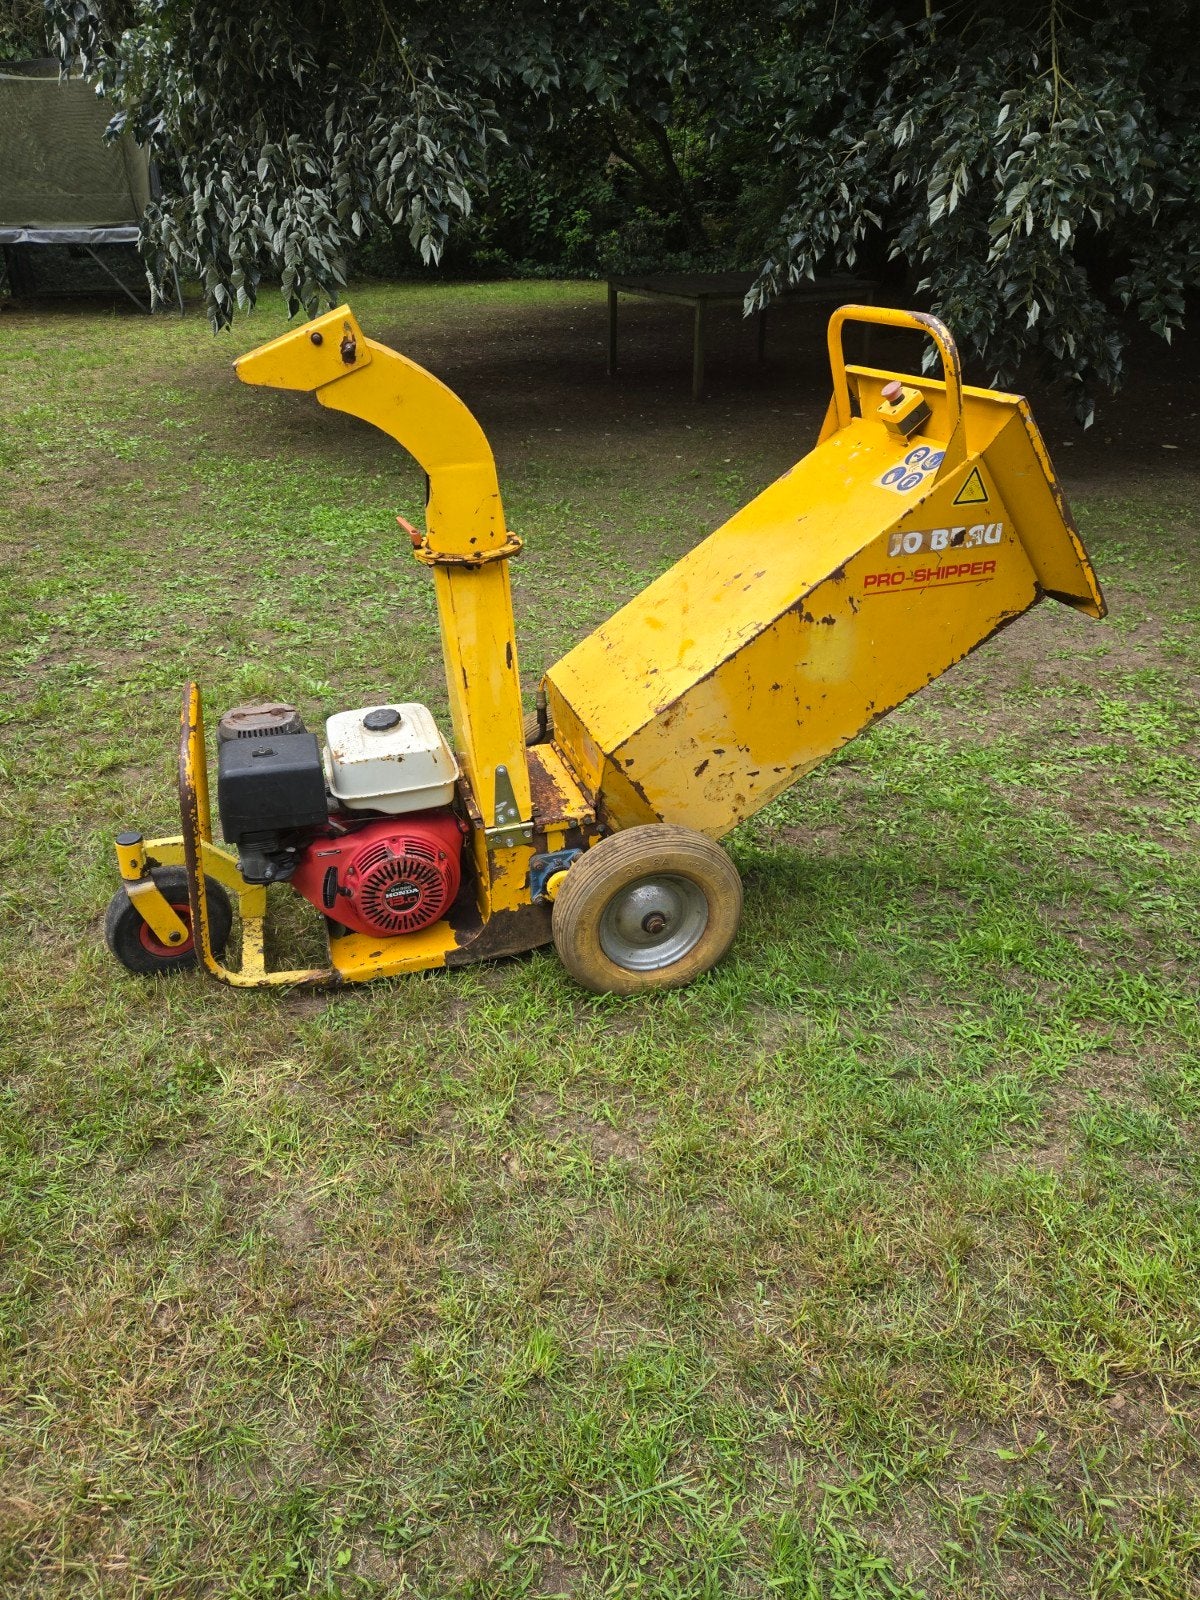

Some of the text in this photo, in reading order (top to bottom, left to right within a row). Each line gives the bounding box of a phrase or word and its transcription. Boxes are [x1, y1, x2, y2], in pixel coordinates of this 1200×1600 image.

[890, 532, 923, 557] JO
[864, 560, 996, 588] PRO-SHIPPER
[385, 888, 419, 898] HONDA
